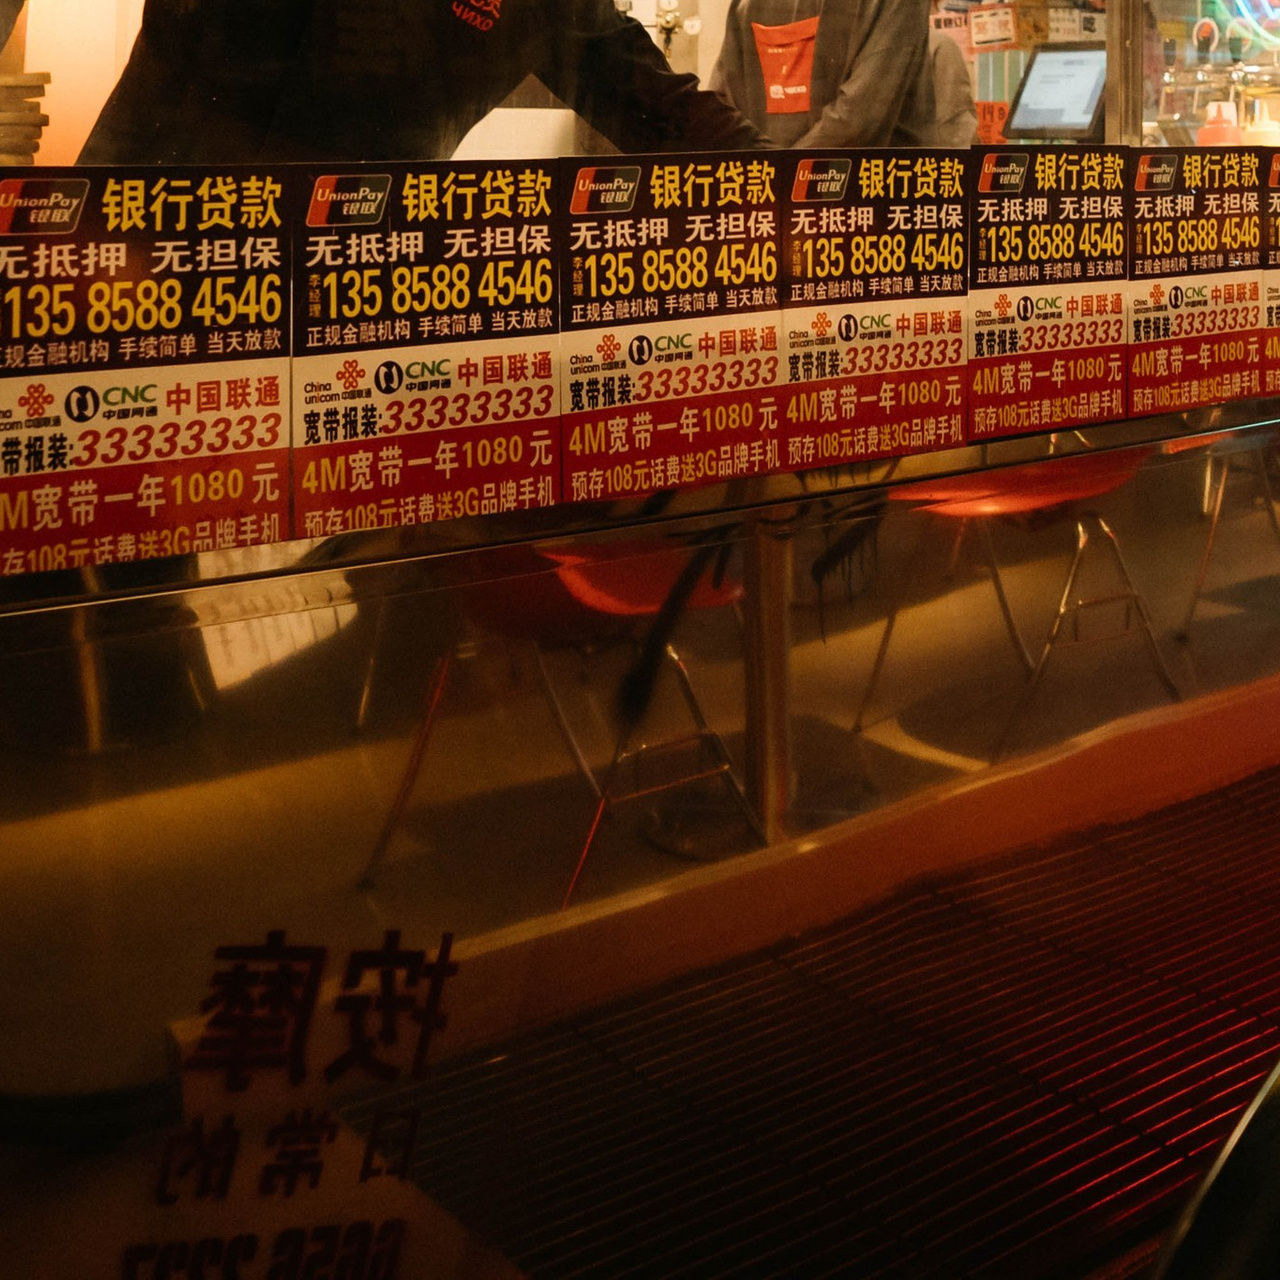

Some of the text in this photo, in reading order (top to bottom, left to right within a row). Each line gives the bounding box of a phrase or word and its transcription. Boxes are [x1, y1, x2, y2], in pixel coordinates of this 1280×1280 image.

[579, 176, 635, 192] UnionPay
[650, 159, 775, 210] 银行贷款
[799, 168, 846, 181] UnionPay
[858, 157, 963, 200] 银行贷款
[1034, 152, 1124, 191] 银行贷款
[1183, 152, 1258, 189] 银行贷款
[0, 191, 80, 209] UnionPay
[101, 175, 282, 234] 银行贷款
[317, 185, 384, 202] UnionPay
[402, 168, 551, 223] 银行贷款
[1134, 192, 1258, 219] 无抵押 无担保
[790, 203, 963, 235] 无抵押 无担保
[977, 195, 1123, 223] 无抵押 无担保
[569, 210, 775, 251] 无抵押 无担保
[987, 221, 1123, 262] 135 8588 4546
[1143, 216, 1259, 255] 135 8588 4546
[150, 236, 281, 273] 无担保
[305, 224, 551, 268] 无抵押 无担保
[802, 232, 963, 278] 135 8588 4546
[584, 241, 777, 298] 135 8588 4546
[1043, 261, 1081, 280] 手续简单
[1086, 259, 1123, 277] 当天放款
[322, 258, 552, 319] 135 8588 4546
[791, 273, 963, 301] 正规金融机构 手续简单 当天放款
[1184, 285, 1207, 299] CNC
[1211, 281, 1259, 306] 中国联通
[2, 273, 282, 339] 135 8588 4546
[572, 285, 777, 324] 正规金融机构 手续简单 当天放款
[1035, 296, 1062, 311] CNC
[1066, 293, 1122, 319] 中国联通
[307, 307, 552, 348] 正规金融机构 手续简单 当天放款
[789, 329, 808, 339] China
[859, 314, 891, 331] CNC
[896, 309, 962, 338] 中国联通
[119, 328, 281, 361] 手续简单 当天放款
[654, 333, 692, 353] CNC
[698, 325, 777, 359] 中国联通
[405, 358, 450, 380] CNC
[458, 350, 552, 388] 中国联通
[570, 353, 592, 365] China
[570, 362, 600, 375] unicom
[654, 350, 692, 364] 中国网通
[102, 383, 157, 407] CNC
[166, 375, 280, 416] 中国联通
[304, 380, 331, 394] China
[304, 390, 340, 405] unicom
[405, 378, 451, 393] 中国网通
